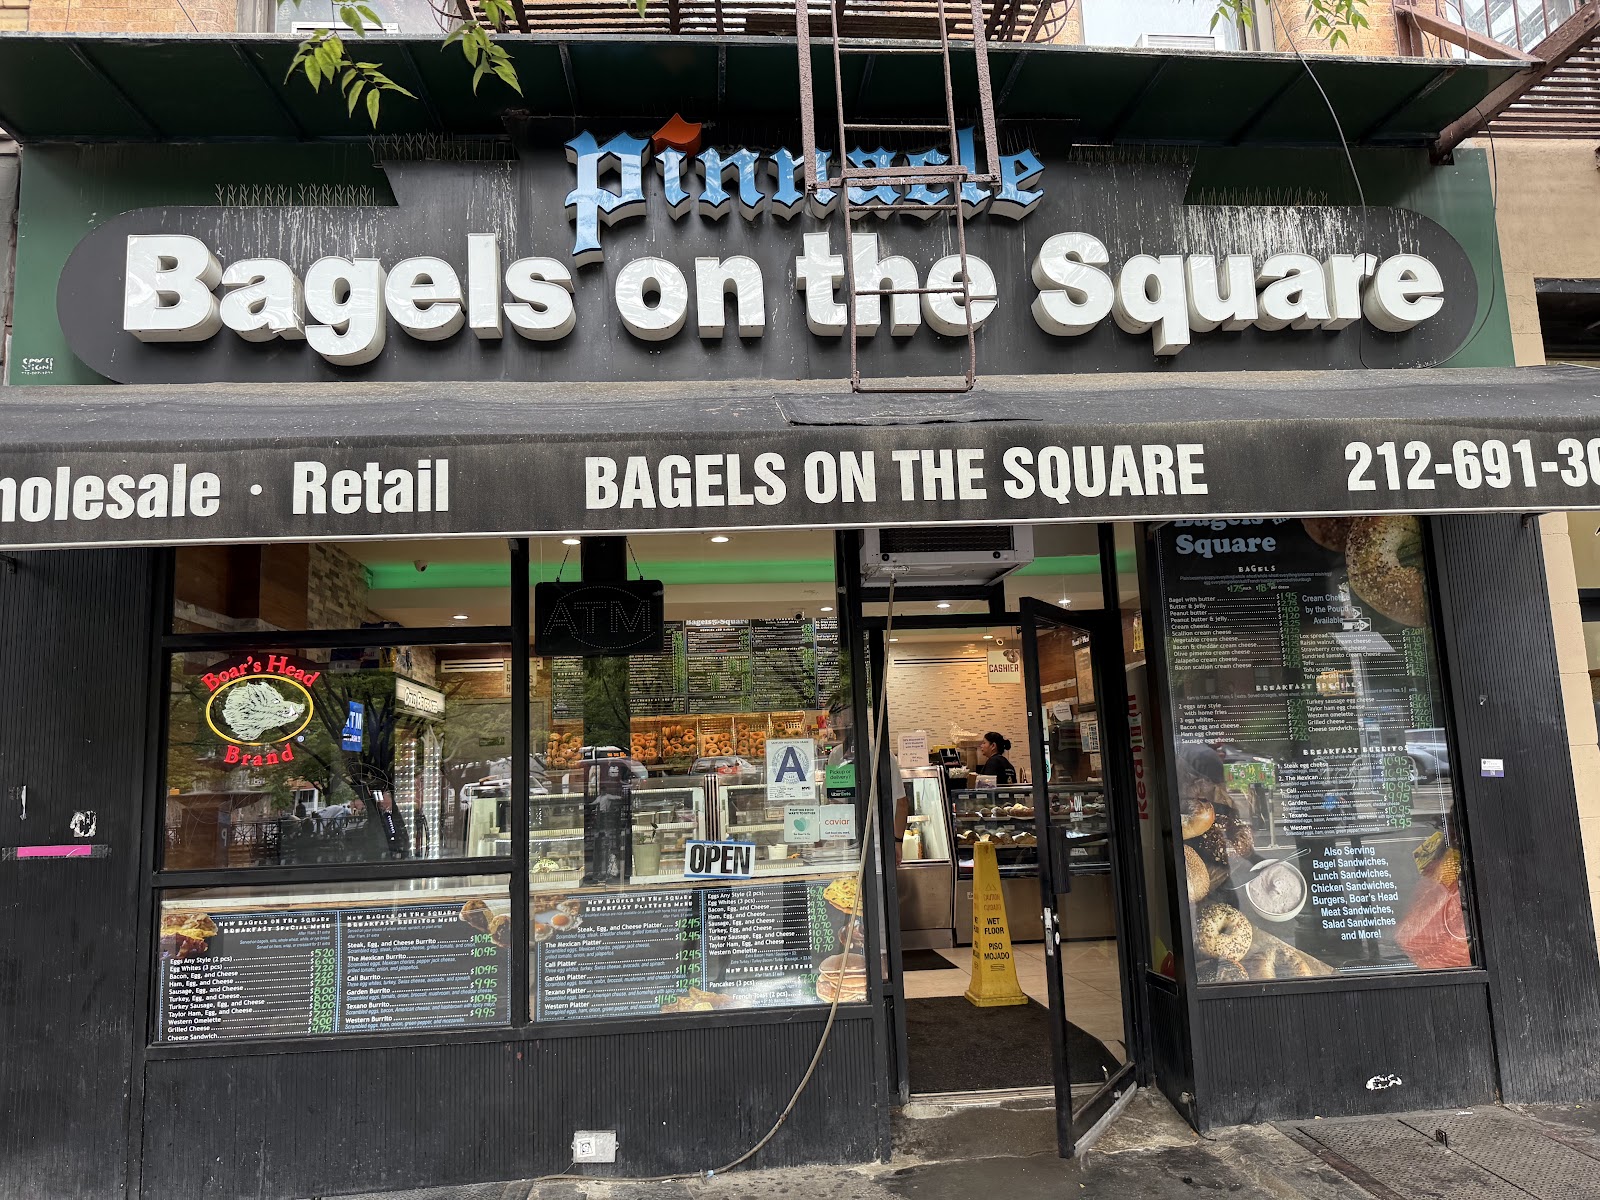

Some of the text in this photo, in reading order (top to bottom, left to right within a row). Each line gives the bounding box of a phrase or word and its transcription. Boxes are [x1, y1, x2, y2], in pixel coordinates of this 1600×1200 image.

[123, 231, 1445, 368] Bagels on the Square
[584, 443, 1209, 510] BAGELS ON THE SQUARE
[292, 458, 450, 516] Retail
[1176, 534, 1276, 558] Square
[543, 600, 650, 635] ATM
[201, 654, 321, 692] Boar's Head
[989, 664, 1018, 672] CASHIER
[224, 743, 294, 766] Brand
[775, 747, 806, 782] A
[689, 844, 750, 874] OPEN
[1324, 846, 1375, 856] Also Serving
[1313, 857, 1389, 870] Bagel Sandwiches,
[1313, 869, 1391, 881] Lunch Sandwiches,
[1311, 880, 1397, 893] Chicken Sandwiches,
[1313, 892, 1398, 907] Burgers, Boar's Head
[1321, 905, 1394, 916] Meat Sandwiches,
[1322, 917, 1396, 929] Salad Sandwiches
[1341, 929, 1382, 940] and More!
